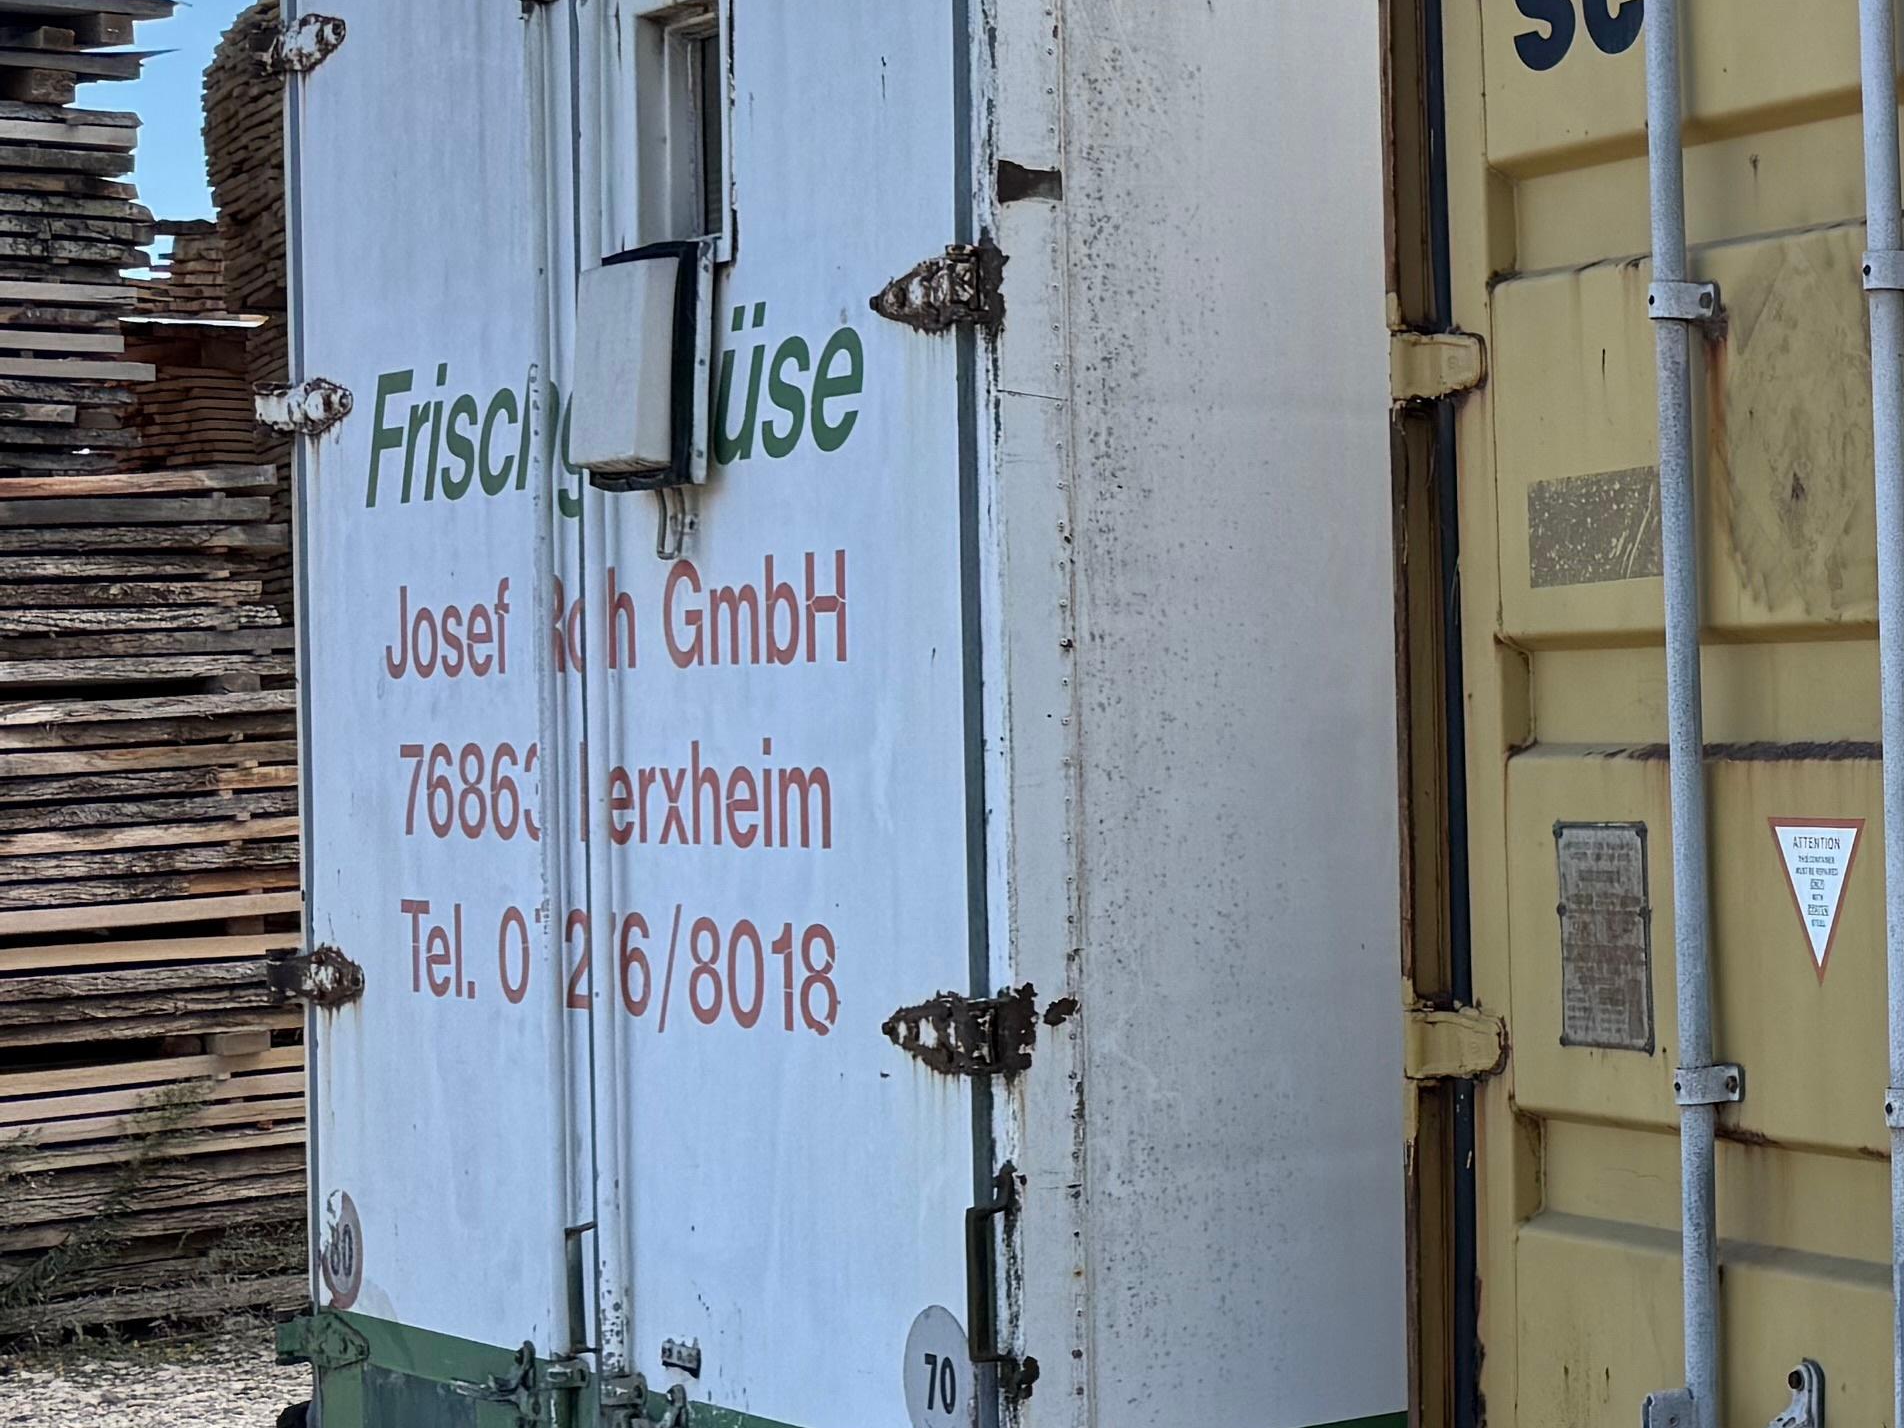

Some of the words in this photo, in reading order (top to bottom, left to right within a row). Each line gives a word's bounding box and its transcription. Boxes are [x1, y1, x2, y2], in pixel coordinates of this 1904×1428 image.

[385, 577, 511, 680] Josef
[662, 549, 849, 670] GmbH
[580, 737, 833, 849] erxheim
[400, 899, 476, 1000] Tel.
[924, 1353, 957, 1415] 70
